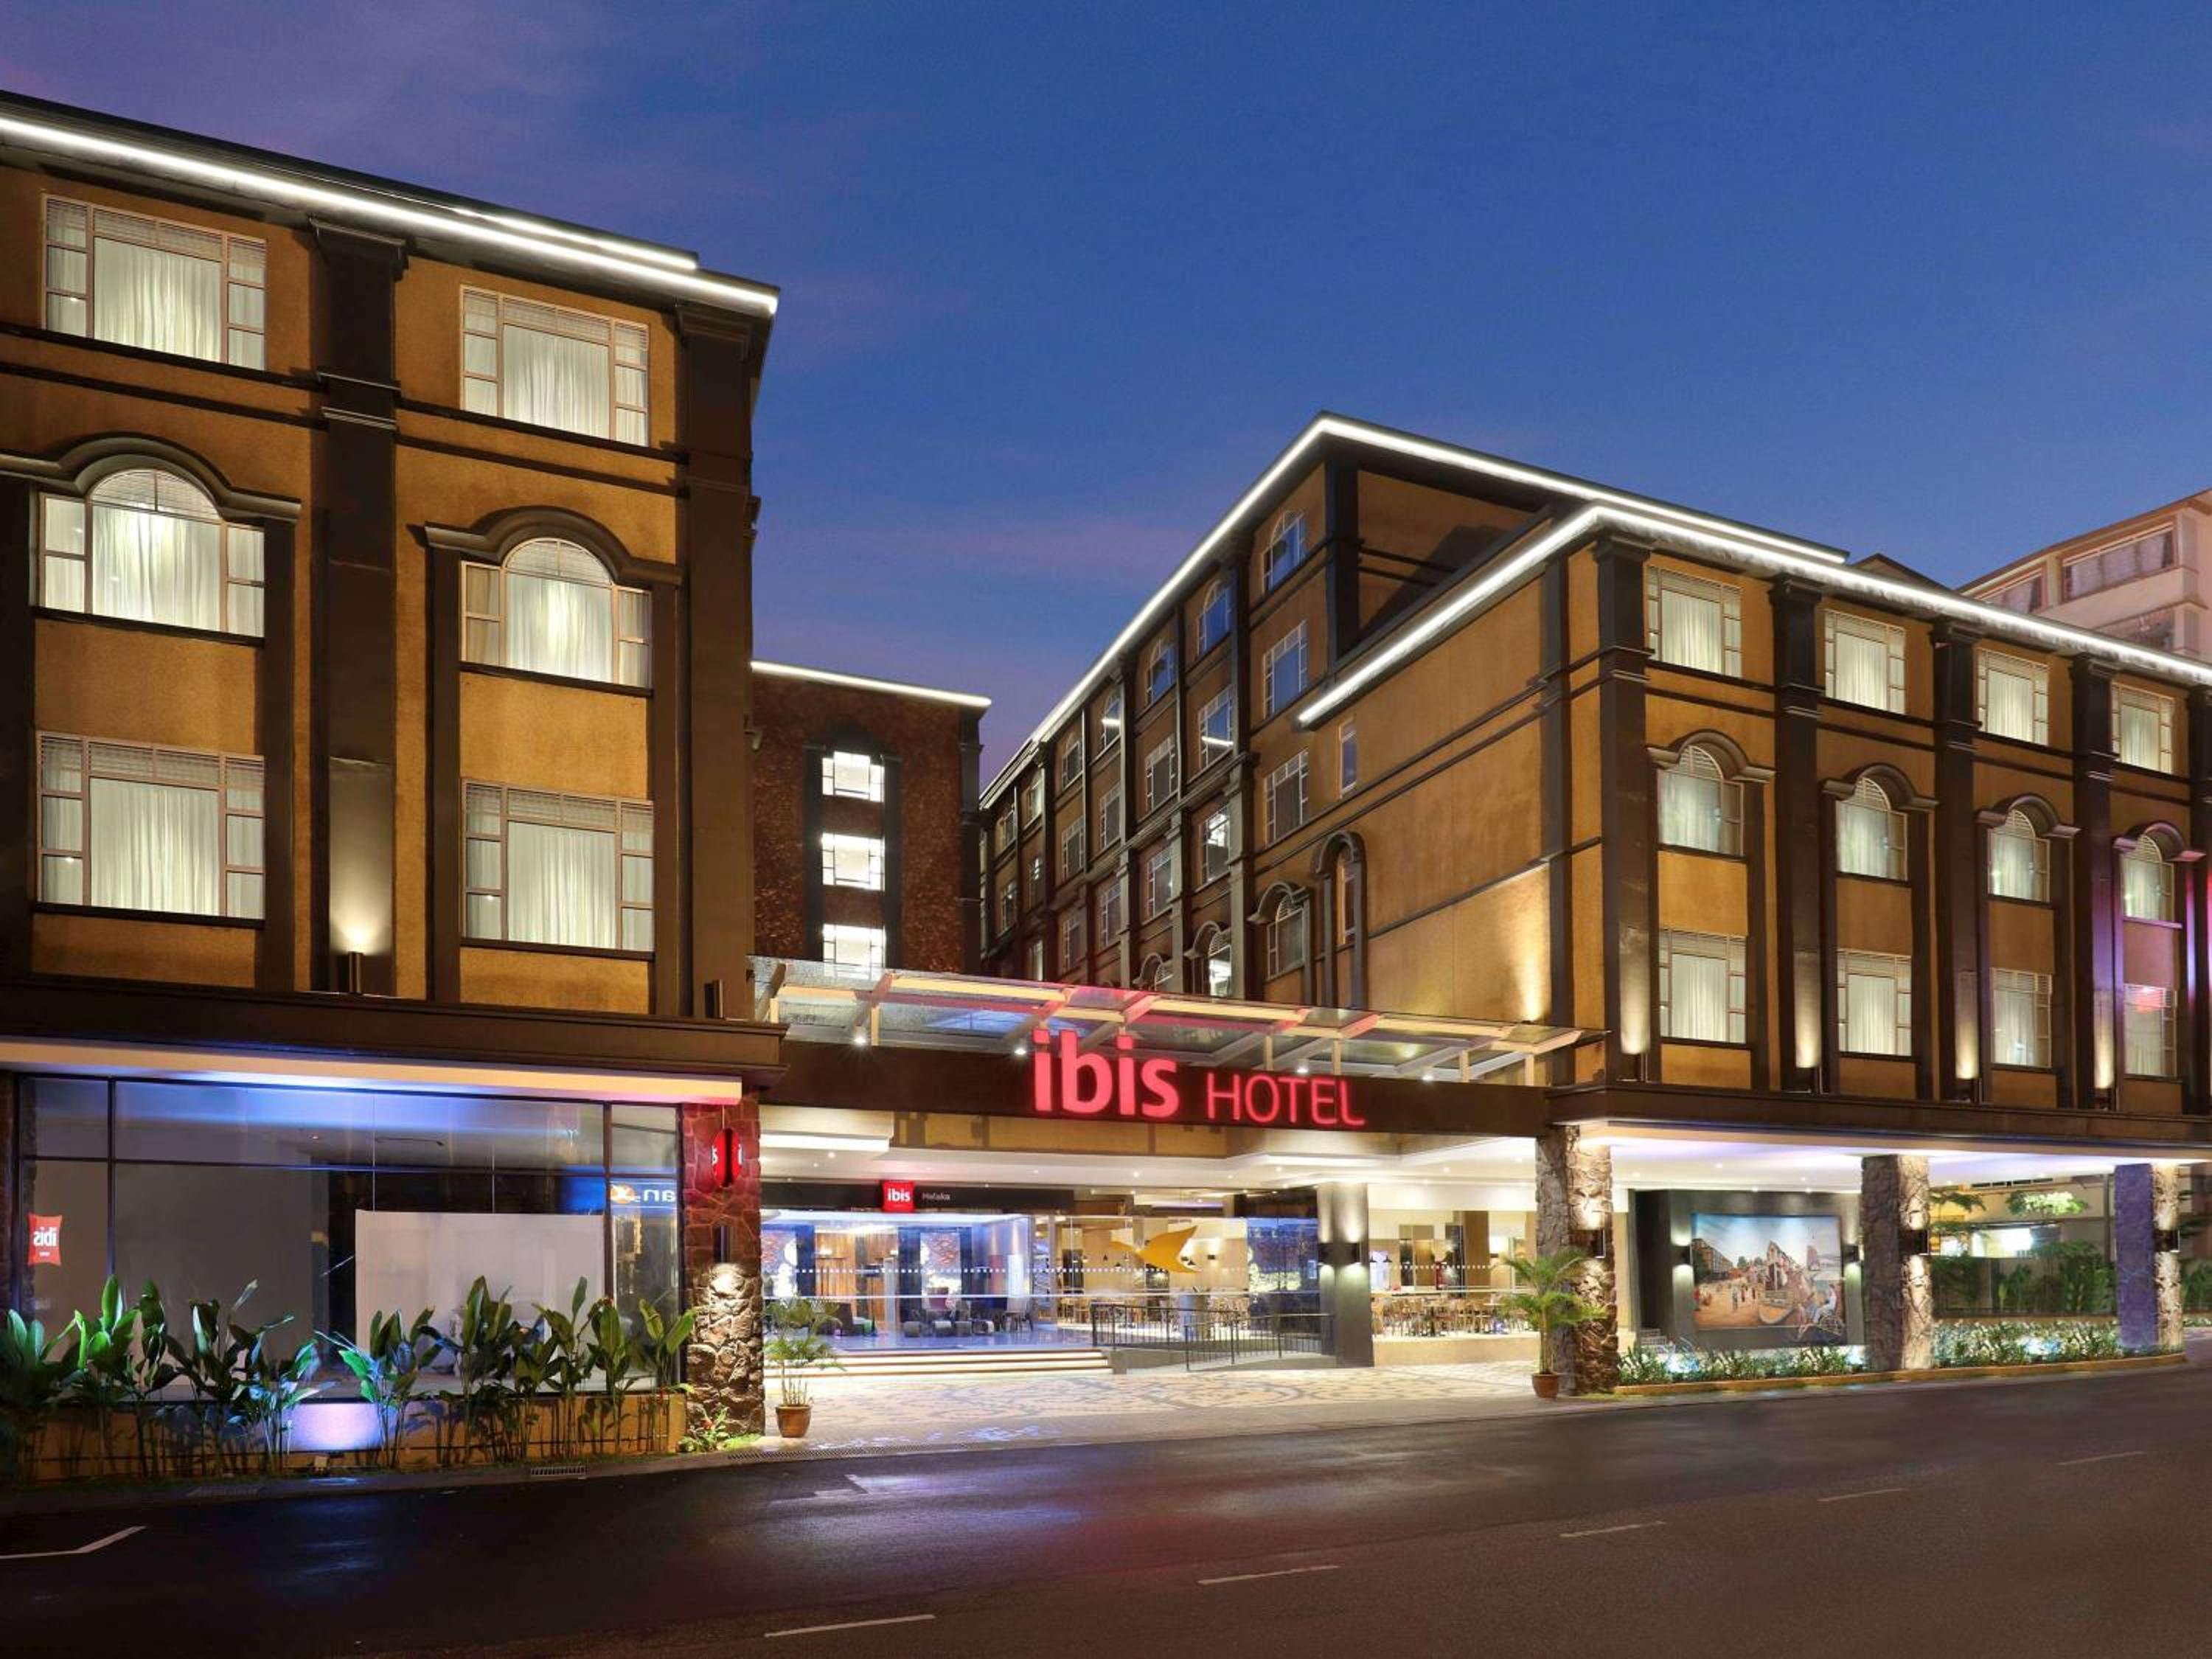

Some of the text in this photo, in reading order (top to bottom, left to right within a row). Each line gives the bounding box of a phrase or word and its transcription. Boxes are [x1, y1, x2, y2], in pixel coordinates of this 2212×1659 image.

[1032, 1027, 1366, 1128] ibis HOTEL
[887, 1187, 911, 1203] ibis
